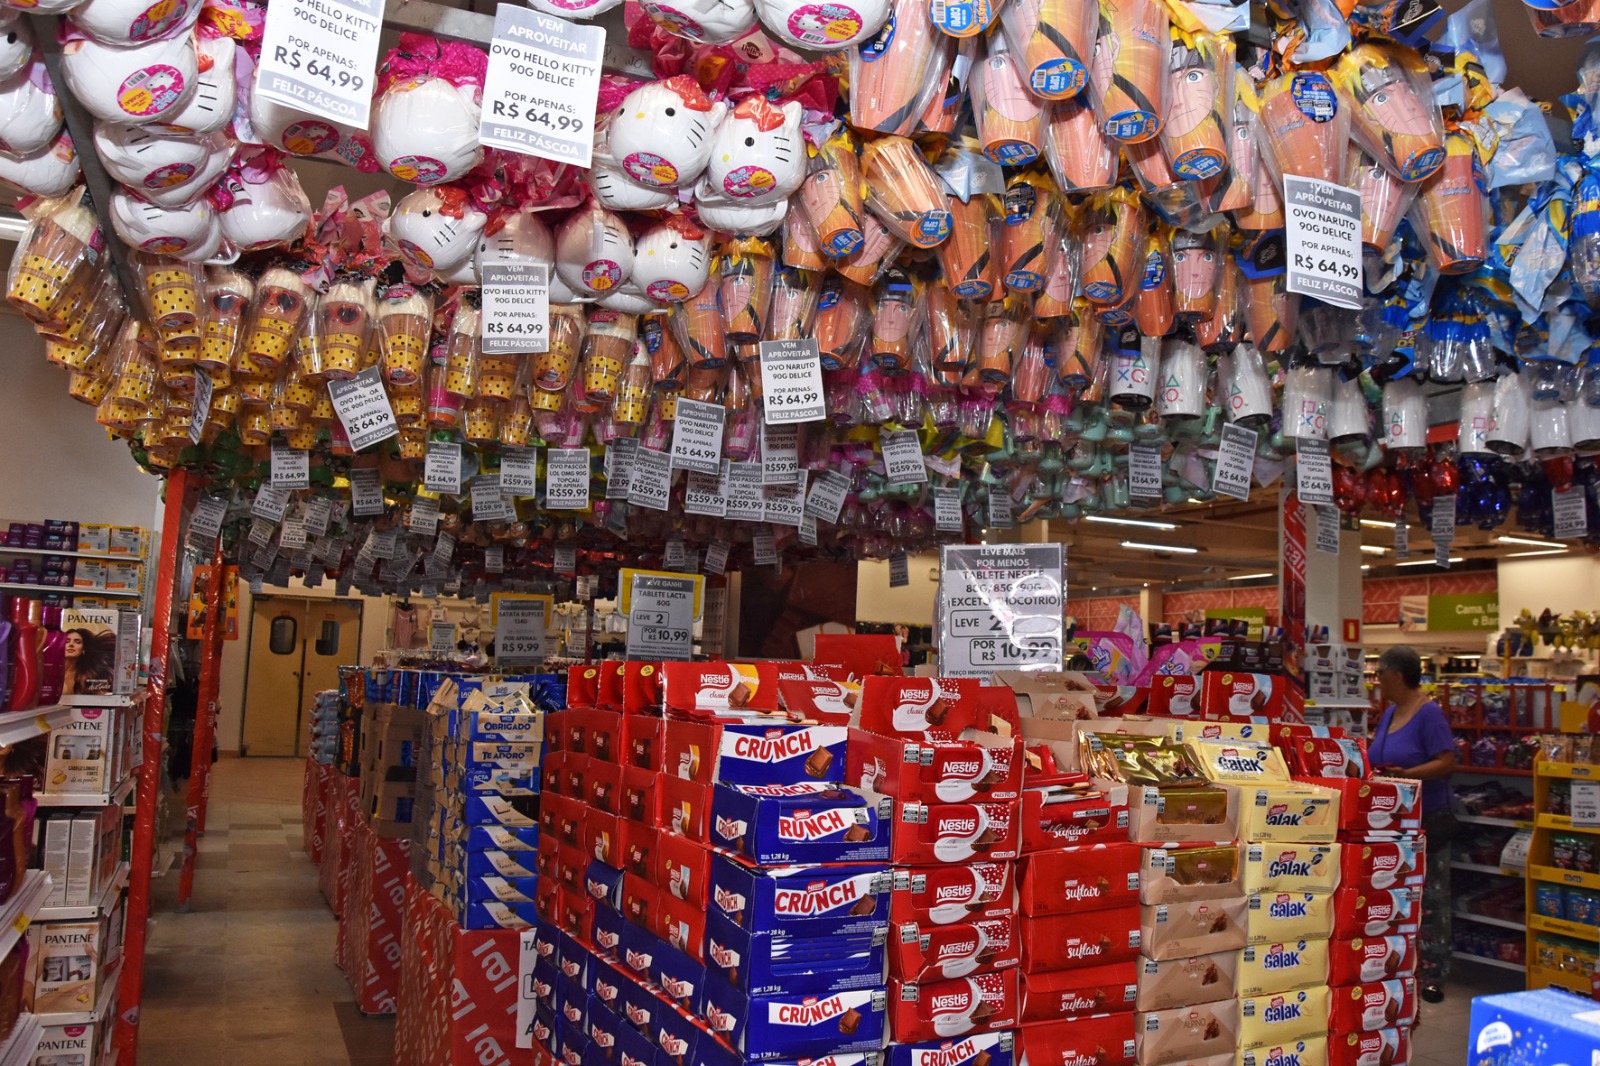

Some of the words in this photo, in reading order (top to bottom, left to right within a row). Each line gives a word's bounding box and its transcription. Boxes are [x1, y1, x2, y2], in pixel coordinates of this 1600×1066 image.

[294, 7, 316, 24] 90G
[320, 19, 358, 41] DELICE
[308, 0, 342, 19] HELLO
[346, 14, 378, 33] KITTY
[537, 17, 563, 33] VEM
[508, 25, 587, 53] APROVEITAR
[288, 35, 309, 51] POR
[313, 46, 357, 70] APENAS:
[275, 45, 301, 70] R$
[307, 60, 363, 91] 64,99
[493, 45, 520, 58] OVO
[524, 52, 559, 69] HELLO
[563, 63, 595, 76] KITTY
[510, 63, 533, 77] 90G
[537, 71, 575, 87] DELICE
[273, 78, 305, 98] FELIZ
[308, 92, 357, 116] PÁSCOA
[505, 91, 526, 102] POR
[530, 97, 576, 114] APENAS:
[493, 101, 519, 119] R$
[526, 108, 583, 133] 64,99
[494, 128, 526, 141] FELIZ
[529, 136, 579, 155] PÁSCOA
[1295, 192, 1352, 212] APROVEITAR
[1293, 208, 1316, 219] OVO
[1319, 214, 1355, 230] NARUTO
[1300, 222, 1320, 233] 90G
[1323, 227, 1352, 241] DELICE
[1302, 241, 1318, 249] POR
[1321, 245, 1353, 258] APENAS:
[1295, 254, 1313, 270] R$
[1318, 259, 1358, 279] 64,99
[1297, 277, 1320, 289] FELIZ
[1323, 281, 1358, 298] PÁSCOA
[488, 322, 503, 334] R$
[507, 323, 543, 335] 64,99
[511, 339, 542, 347] PÁSCOA
[768, 350, 811, 358] APROVEITAR
[786, 362, 815, 370] NARUTO
[769, 395, 783, 405] R$
[786, 393, 817, 405] 64,99
[682, 409, 717, 420] APROVEITAR
[791, 409, 818, 418] PÁSCOA
[349, 424, 359, 435] R$
[362, 413, 389, 429] 64,99
[694, 422, 718, 431] NARUTO
[676, 446, 687, 456] R$
[690, 448, 716, 459] 64,99
[676, 459, 690, 467] FELIZ
[691, 461, 713, 469] PÁSCOA
[285, 472, 305, 480] 64,99
[1219, 469, 1229, 479] R$
[1230, 472, 1248, 484] 64,99
[550, 488, 587, 498] R$59,99
[632, 484, 668, 498] R$59,99
[1311, 482, 1331, 491] 64,99
[687, 494, 725, 505] R$59,99
[727, 500, 763, 510] R$59,99
[998, 559, 1030, 567] MENOS
[662, 580, 683, 588] GANHE
[639, 591, 668, 599] TABLETE
[1456, 604, 1485, 615] Cama,
[68, 615, 113, 624] PANTENE
[656, 614, 664, 623] 2
[955, 619, 979, 627] LEVE
[989, 615, 1002, 630] 2
[658, 631, 688, 642] 10,99
[502, 643, 515, 652] R$
[518, 643, 539, 653] 9,99
[973, 641, 995, 649] POR
[982, 652, 995, 661] R$
[1001, 642, 1052, 660] 10,99
[484, 722, 531, 730] OBRIGADO
[735, 731, 812, 760] CRUNCH
[482, 751, 491, 759] TE
[718, 821, 739, 838] CRUNCH
[780, 810, 844, 837] RUNCH
[1269, 860, 1310, 878] Galak
[775, 880, 856, 913] CRUNCH
[1065, 885, 1100, 901] suflair
[717, 892, 738, 911] CRUNCH
[1192, 913, 1215, 921] ALPINO
[1270, 902, 1306, 917] Galak
[45, 934, 93, 944] PANTENE
[1067, 943, 1102, 959] suflair
[1264, 951, 1300, 969] Galak
[779, 996, 843, 1025] CRUNCH
[1265, 1004, 1301, 1022] Galak
[38, 1039, 86, 1050] PANTENE
[921, 1040, 975, 1066] CRUNCH
